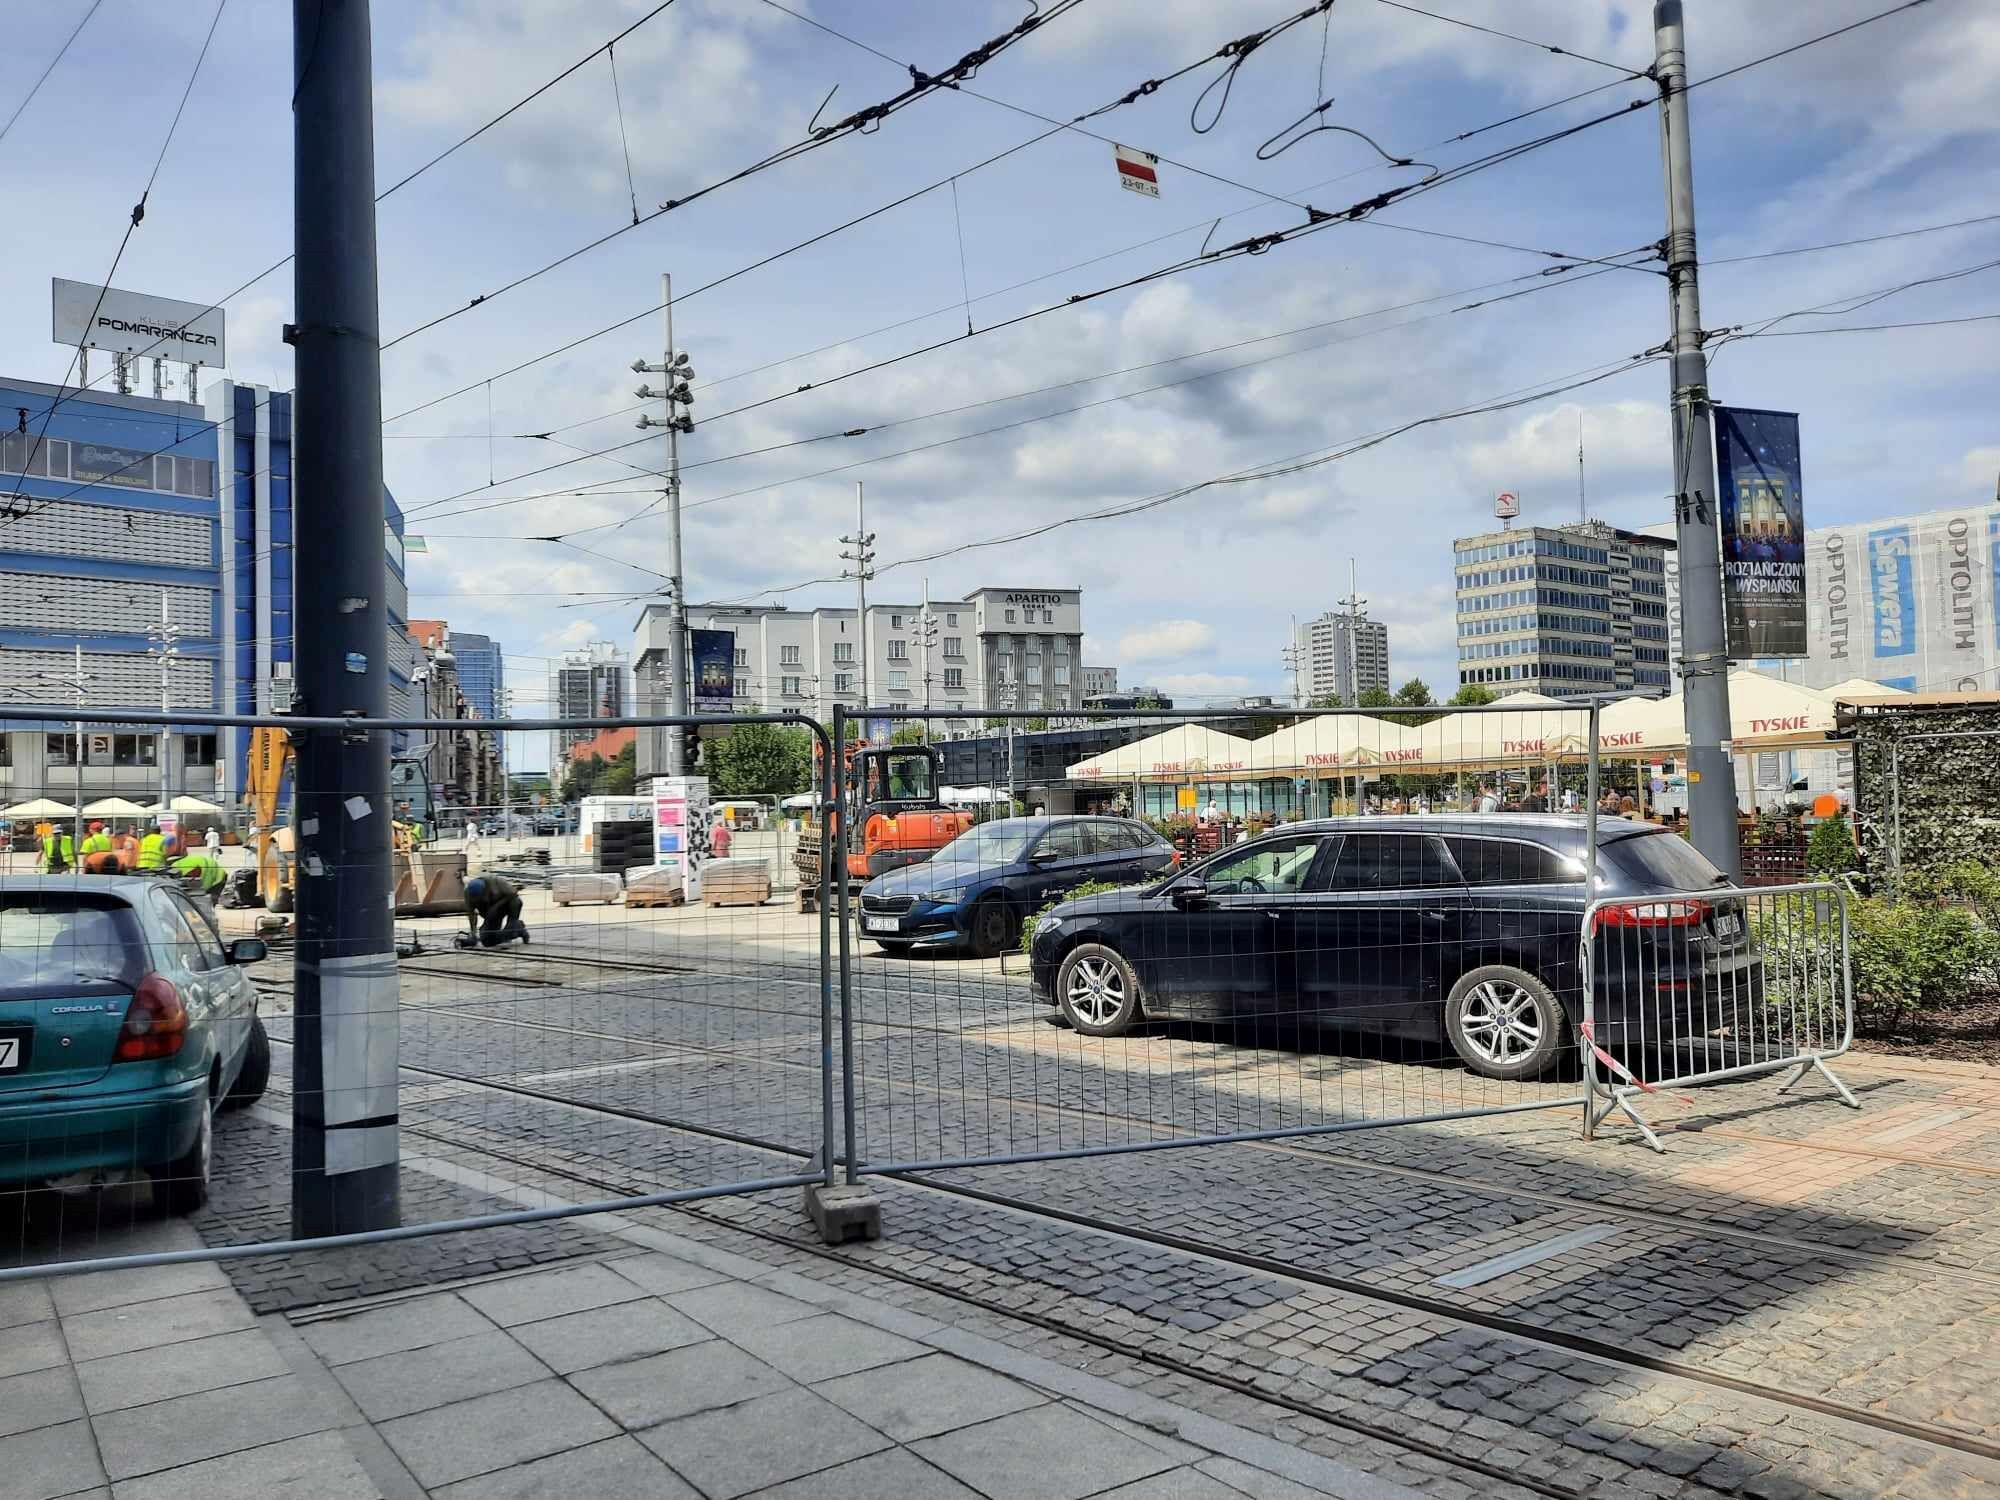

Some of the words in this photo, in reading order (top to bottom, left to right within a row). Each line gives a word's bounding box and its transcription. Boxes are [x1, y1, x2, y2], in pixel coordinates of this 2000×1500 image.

[98, 317, 217, 347] POMARAŃCZA
[1948, 518, 1976, 649] OPTOLITH
[1005, 593, 1061, 604] APARTIO
[1825, 534, 1849, 660] OPTOLITH
[1875, 536, 1907, 648] Sewera
[1752, 716, 1810, 733] TYSKIE
[1502, 739, 1547, 753] TYSKIE
[1600, 731, 1643, 748] YSKIE
[868, 756, 878, 768] 12
[1305, 753, 1340, 765] TYSKIE
[1384, 748, 1423, 762] TYSKIE
[1077, 767, 1103, 777] TYSKIE
[1152, 762, 1181, 772] TYSKIE
[52, 1004, 103, 1014] COROLLA
